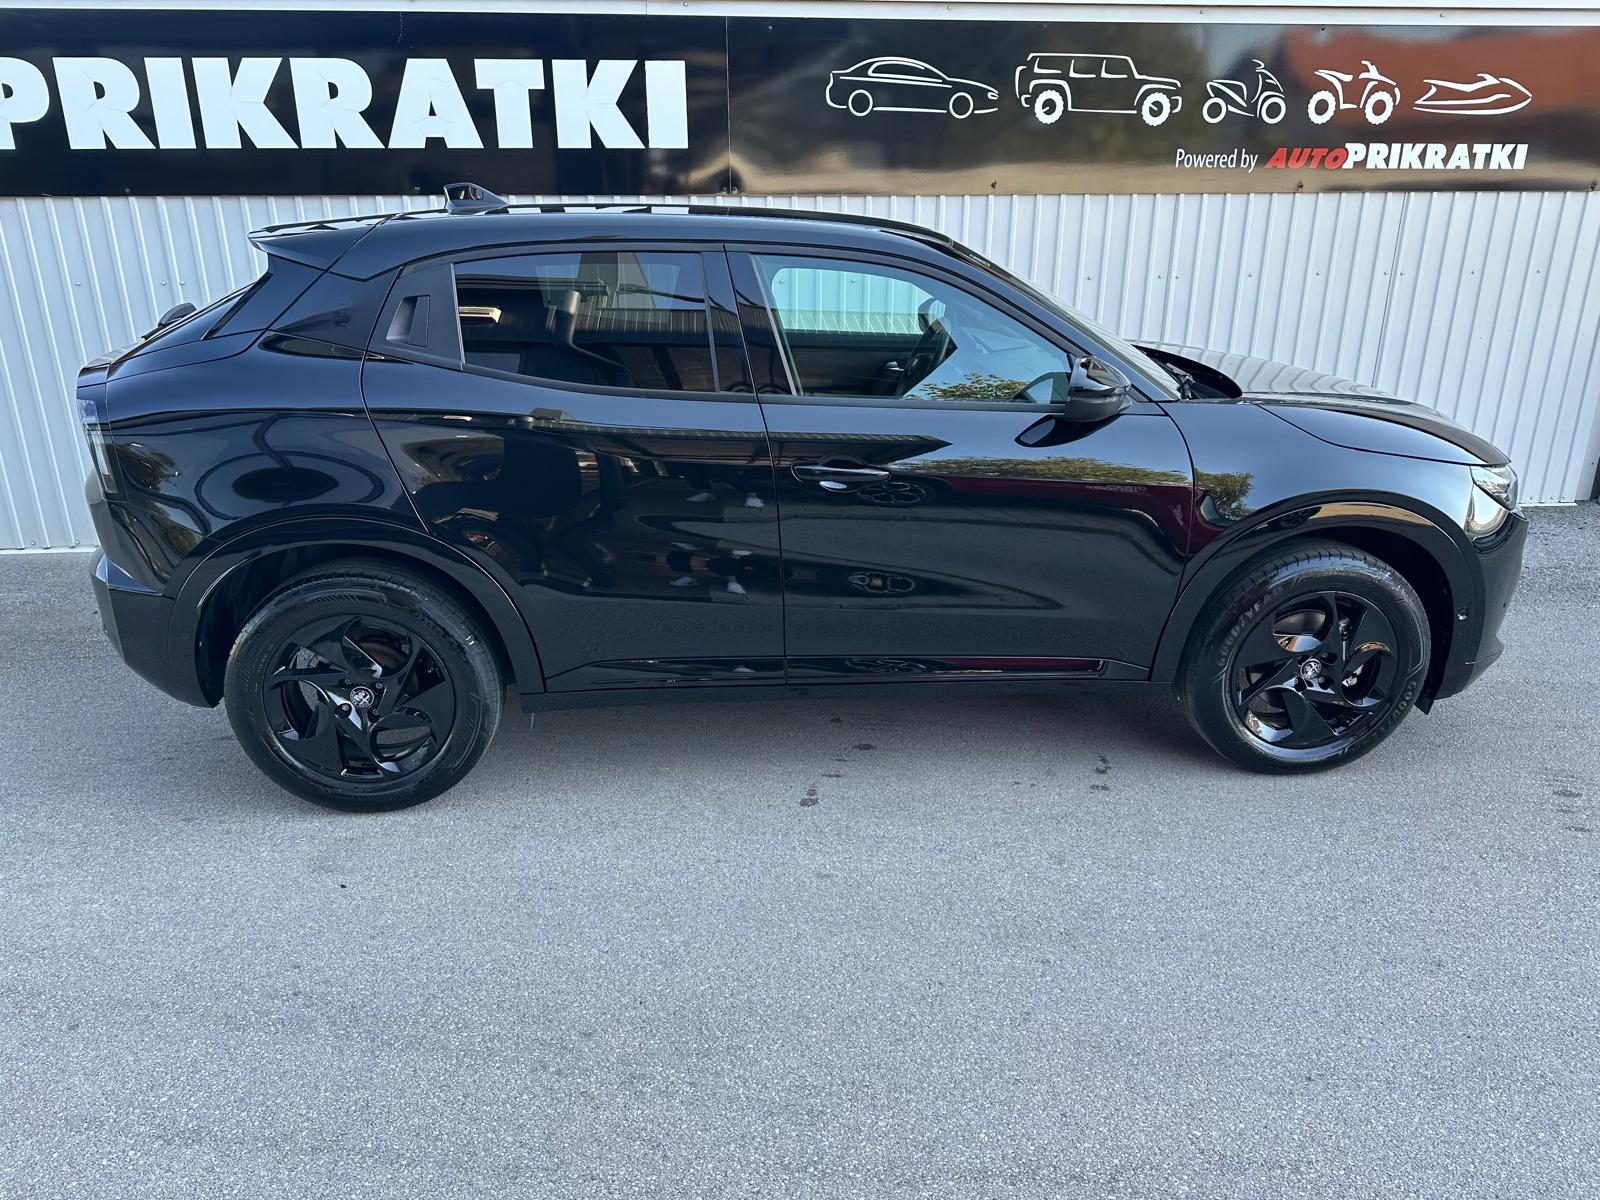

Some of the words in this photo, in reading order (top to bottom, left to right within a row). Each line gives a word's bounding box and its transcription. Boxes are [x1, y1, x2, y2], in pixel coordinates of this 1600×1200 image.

[0, 57, 688, 149] PRIKRATKI
[1175, 148, 1237, 169] Powered
[1240, 149, 1258, 174] by
[1264, 143, 1529, 170] AUTOPRIKRATKI
